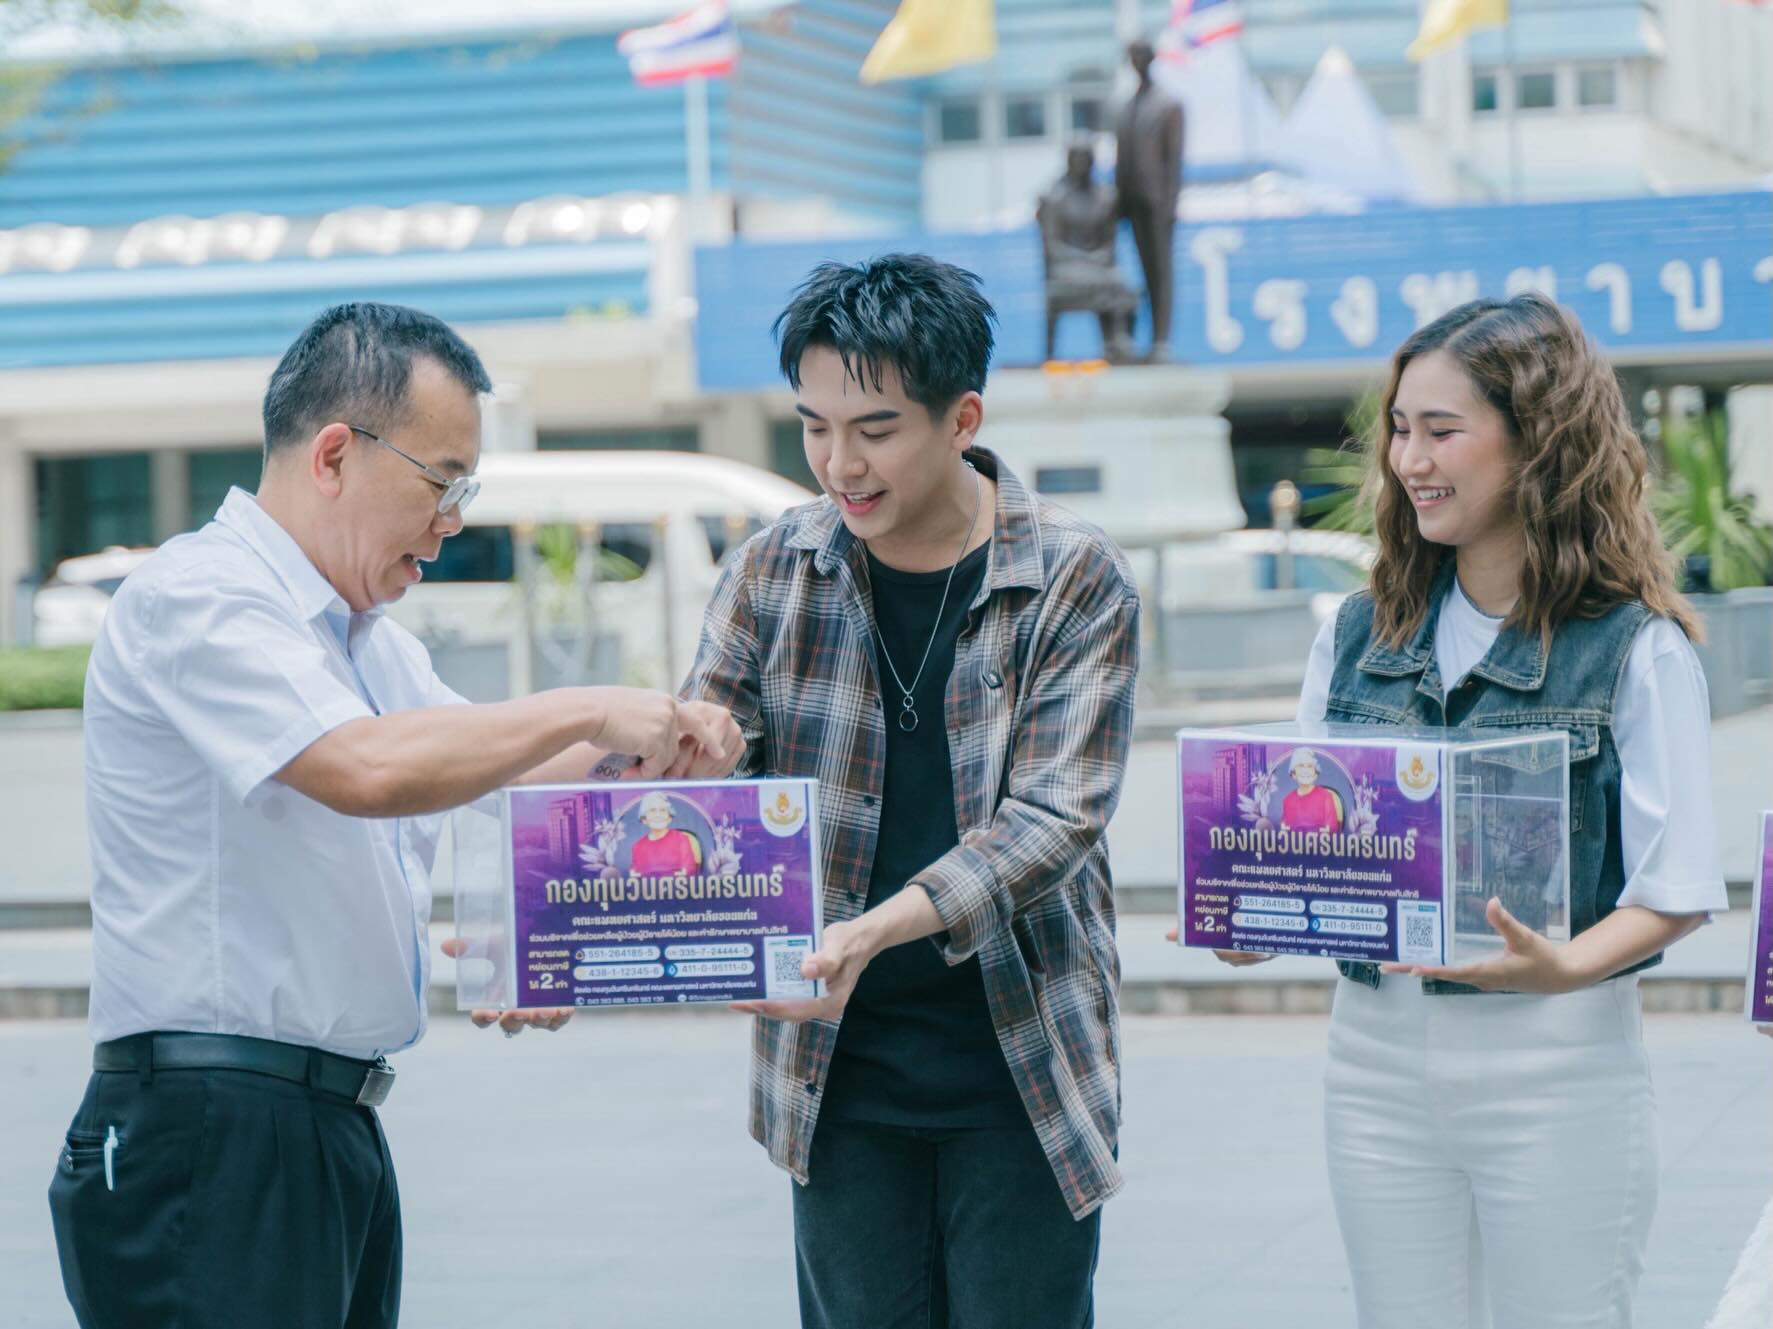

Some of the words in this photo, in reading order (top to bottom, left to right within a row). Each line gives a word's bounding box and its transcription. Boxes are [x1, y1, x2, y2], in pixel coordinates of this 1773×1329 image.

[1208, 826, 1419, 861] กองทุนวันศรีนครินทร์
[546, 865, 786, 912] กองทุนวันศรีนครินทร์
[1204, 916, 1215, 932] 2
[540, 973, 553, 989] 2
